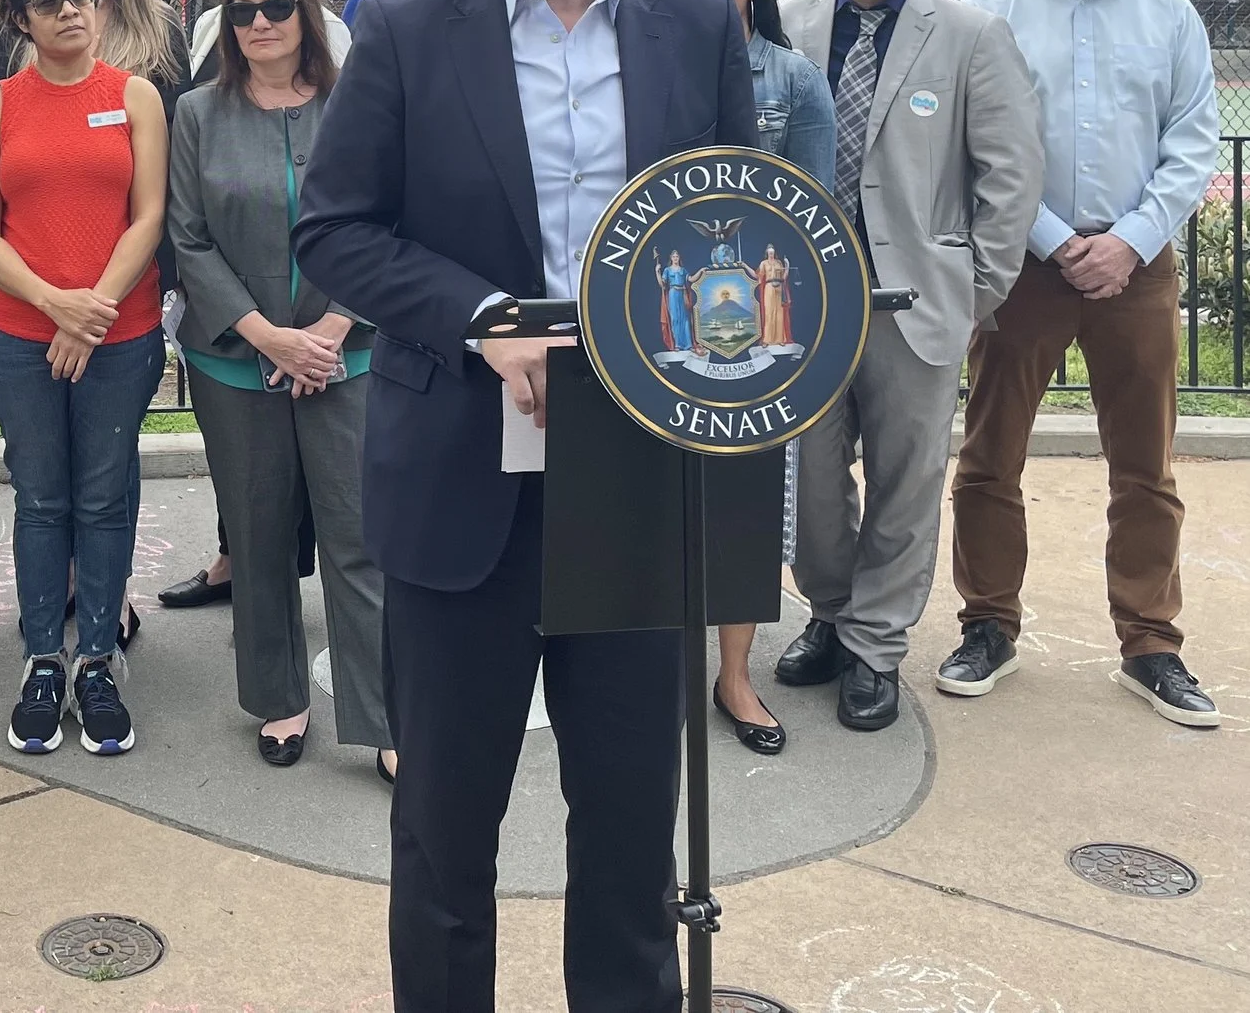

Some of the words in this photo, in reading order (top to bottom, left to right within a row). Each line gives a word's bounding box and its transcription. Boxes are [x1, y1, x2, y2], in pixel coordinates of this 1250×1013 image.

[600, 190, 661, 271] NEW
[660, 162, 762, 201] YORK
[766, 176, 847, 263] STATE
[706, 361, 754, 373] EXCELSIOR
[668, 395, 798, 439] SENATE
